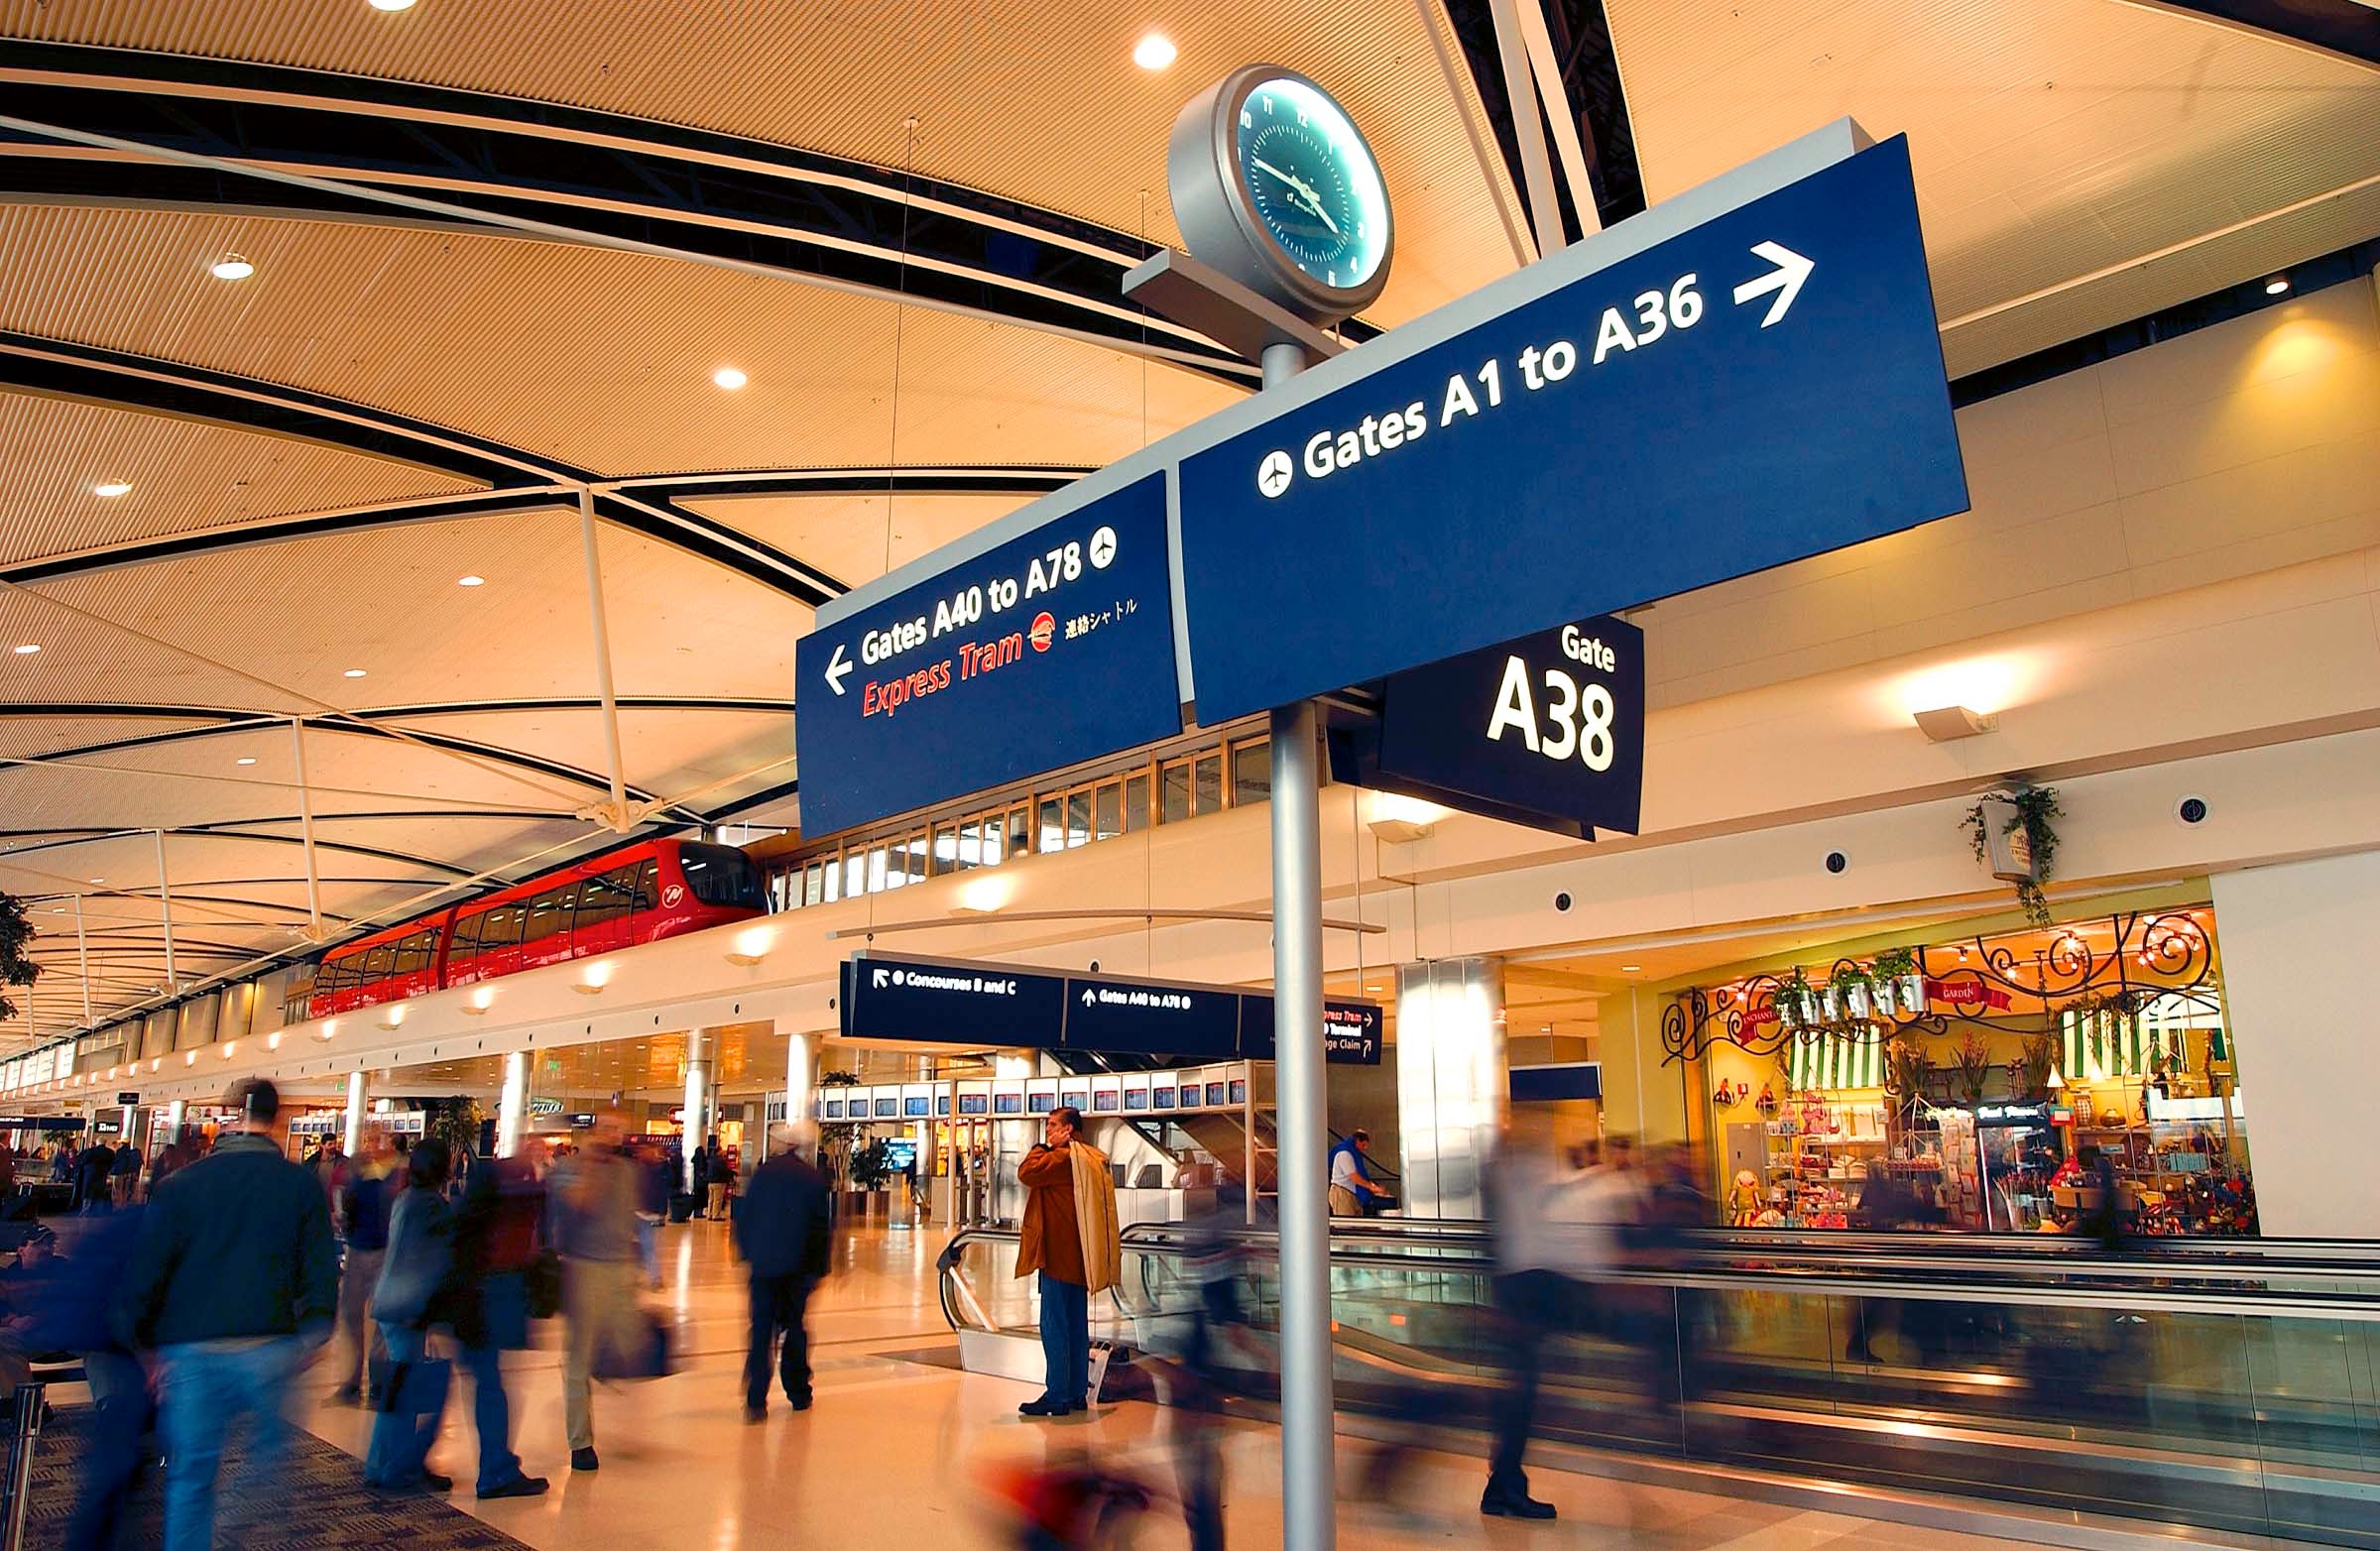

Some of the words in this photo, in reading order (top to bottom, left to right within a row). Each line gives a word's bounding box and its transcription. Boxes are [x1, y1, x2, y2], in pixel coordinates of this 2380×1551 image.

[1261, 94, 1273, 115] 11
[1240, 109, 1252, 129] 10
[1296, 110, 1309, 128] 12
[1357, 221, 1366, 238] 3
[1350, 255, 1359, 274] 4
[1303, 401, 1427, 478] Gates
[1440, 358, 1501, 427] A1
[1518, 340, 1577, 391] to
[1593, 273, 1704, 365] A36
[861, 616, 927, 665] Gates
[932, 585, 983, 639] A40
[988, 578, 1018, 613] to
[1024, 540, 1082, 599] A78
[1065, 598, 1137, 640] 連絡シャトル
[1561, 625, 1615, 672] Gate
[862, 659, 952, 717] Express
[958, 632, 1022, 681] Tram
[1487, 655, 1614, 772] A38
[906, 971, 973, 992] Concourses
[974, 977, 983, 993] B
[984, 979, 1007, 995] and
[1008, 981, 1016, 996] C
[1943, 986, 1973, 999] GARDEN
[1099, 989, 1128, 1005] Gates
[1149, 995, 1161, 1007] to
[1344, 1011, 1363, 1022] Tram
[1743, 1009, 1777, 1023] ENCHANT
[1329, 1022, 1362, 1037] Terminal
[1340, 1038, 1361, 1050] Claim
